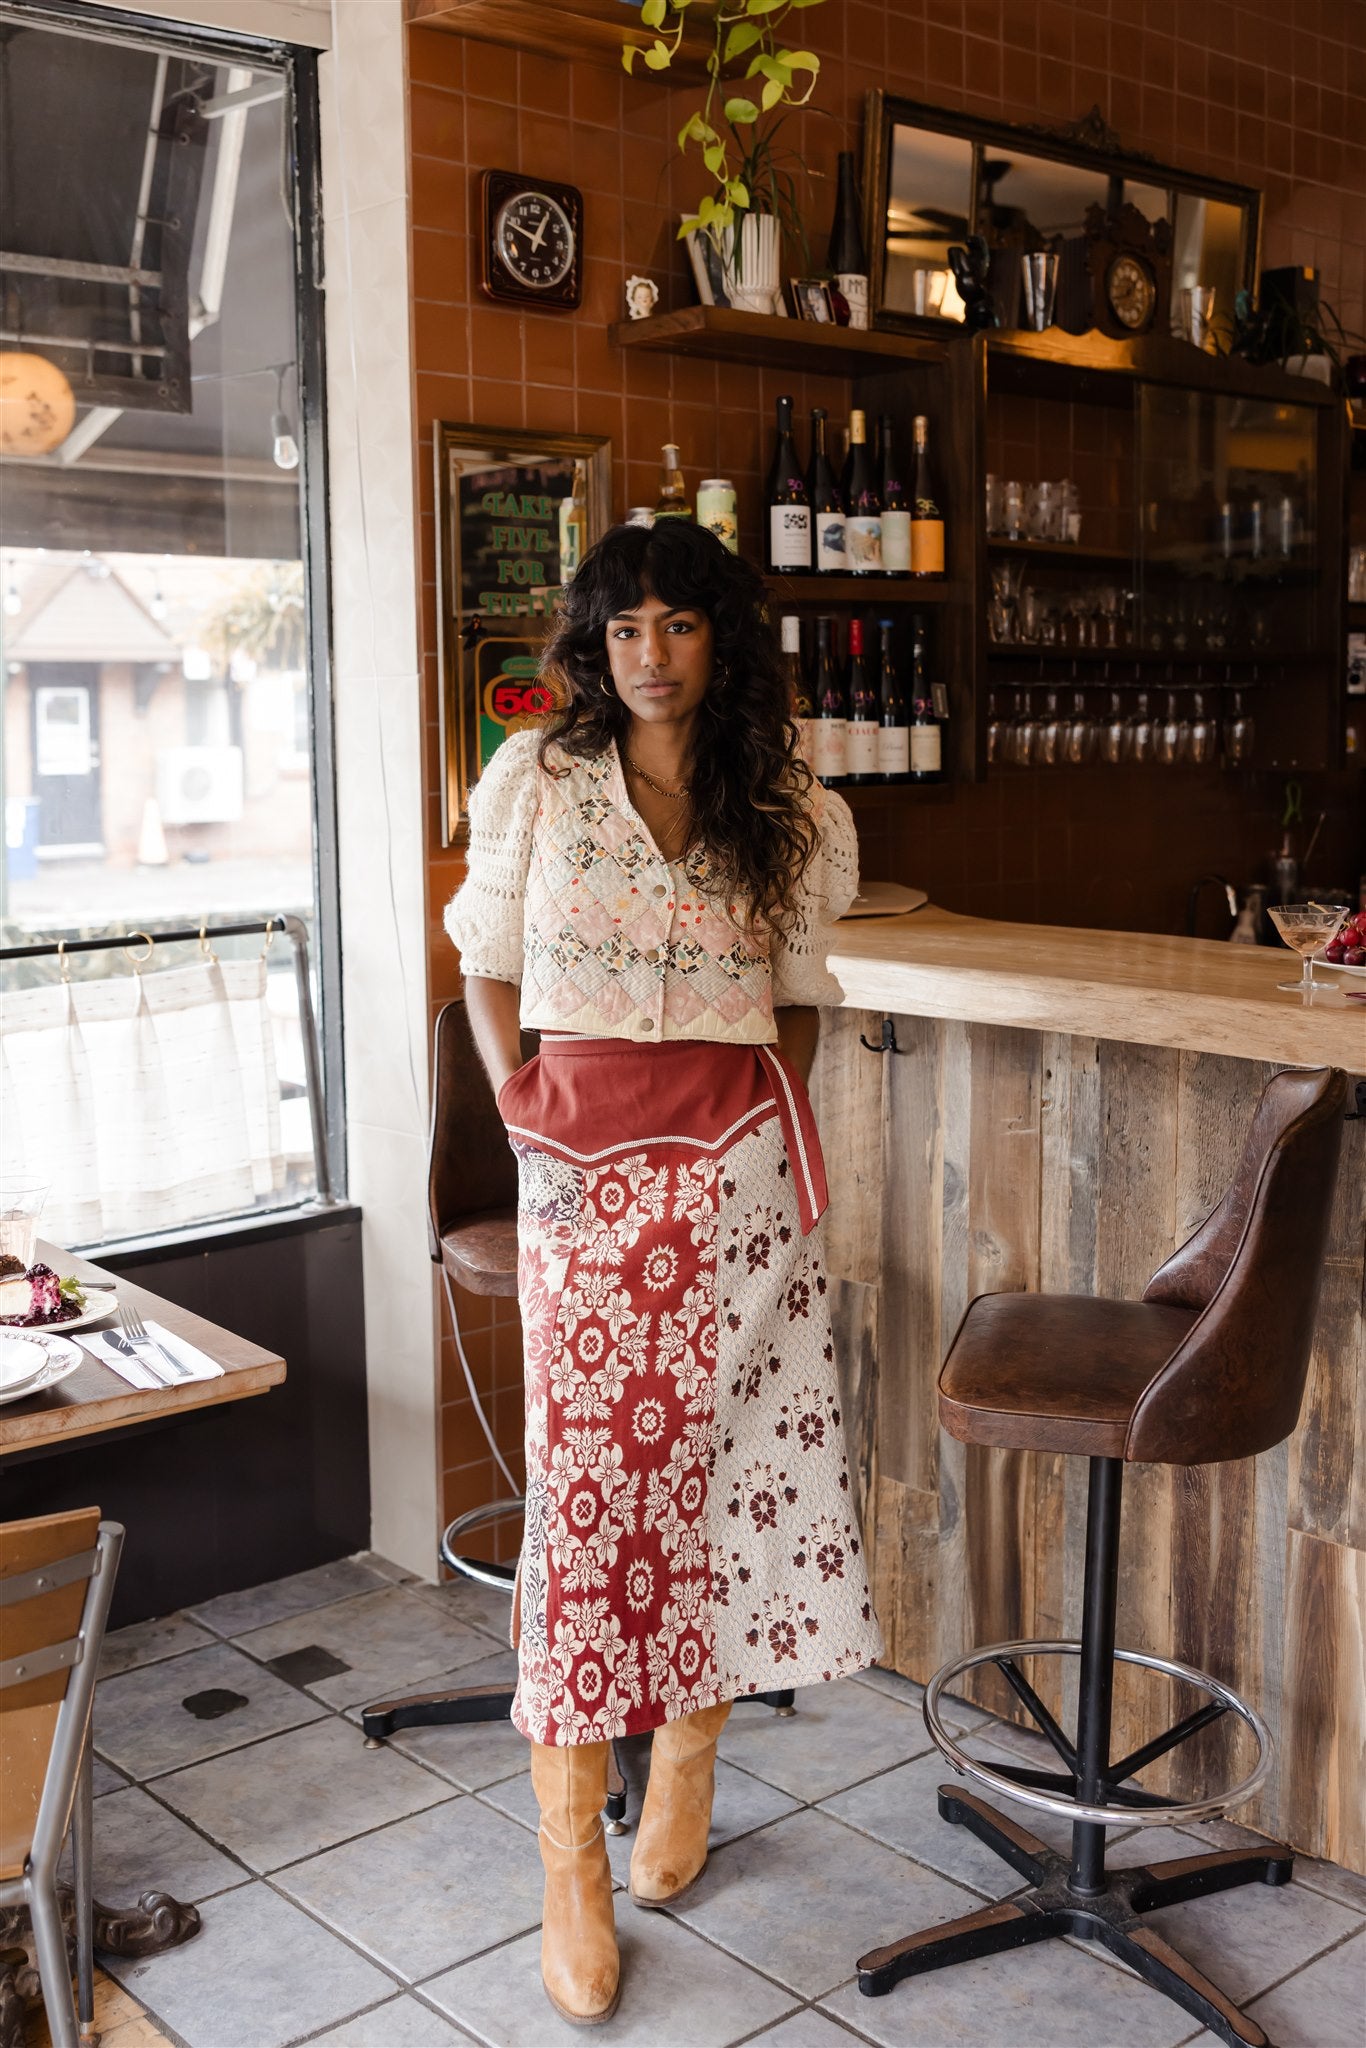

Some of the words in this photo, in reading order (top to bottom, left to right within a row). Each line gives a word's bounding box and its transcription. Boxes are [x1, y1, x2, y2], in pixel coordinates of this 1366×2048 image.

[519, 206, 528, 216] 11
[530, 204, 540, 214] 12
[552, 223, 560, 234] 2
[506, 232, 514, 241] 9
[556, 241, 564, 250] 3
[552, 256, 559, 266] 4
[520, 261, 527, 272] 7
[543, 266, 551, 276] 5
[531, 268, 540, 278] 6
[482, 492, 553, 520] TAKE
[492, 525, 550, 552] FIVE
[497, 560, 546, 585] FOR
[479, 591, 562, 618] FIFTY
[494, 687, 554, 715] 50
